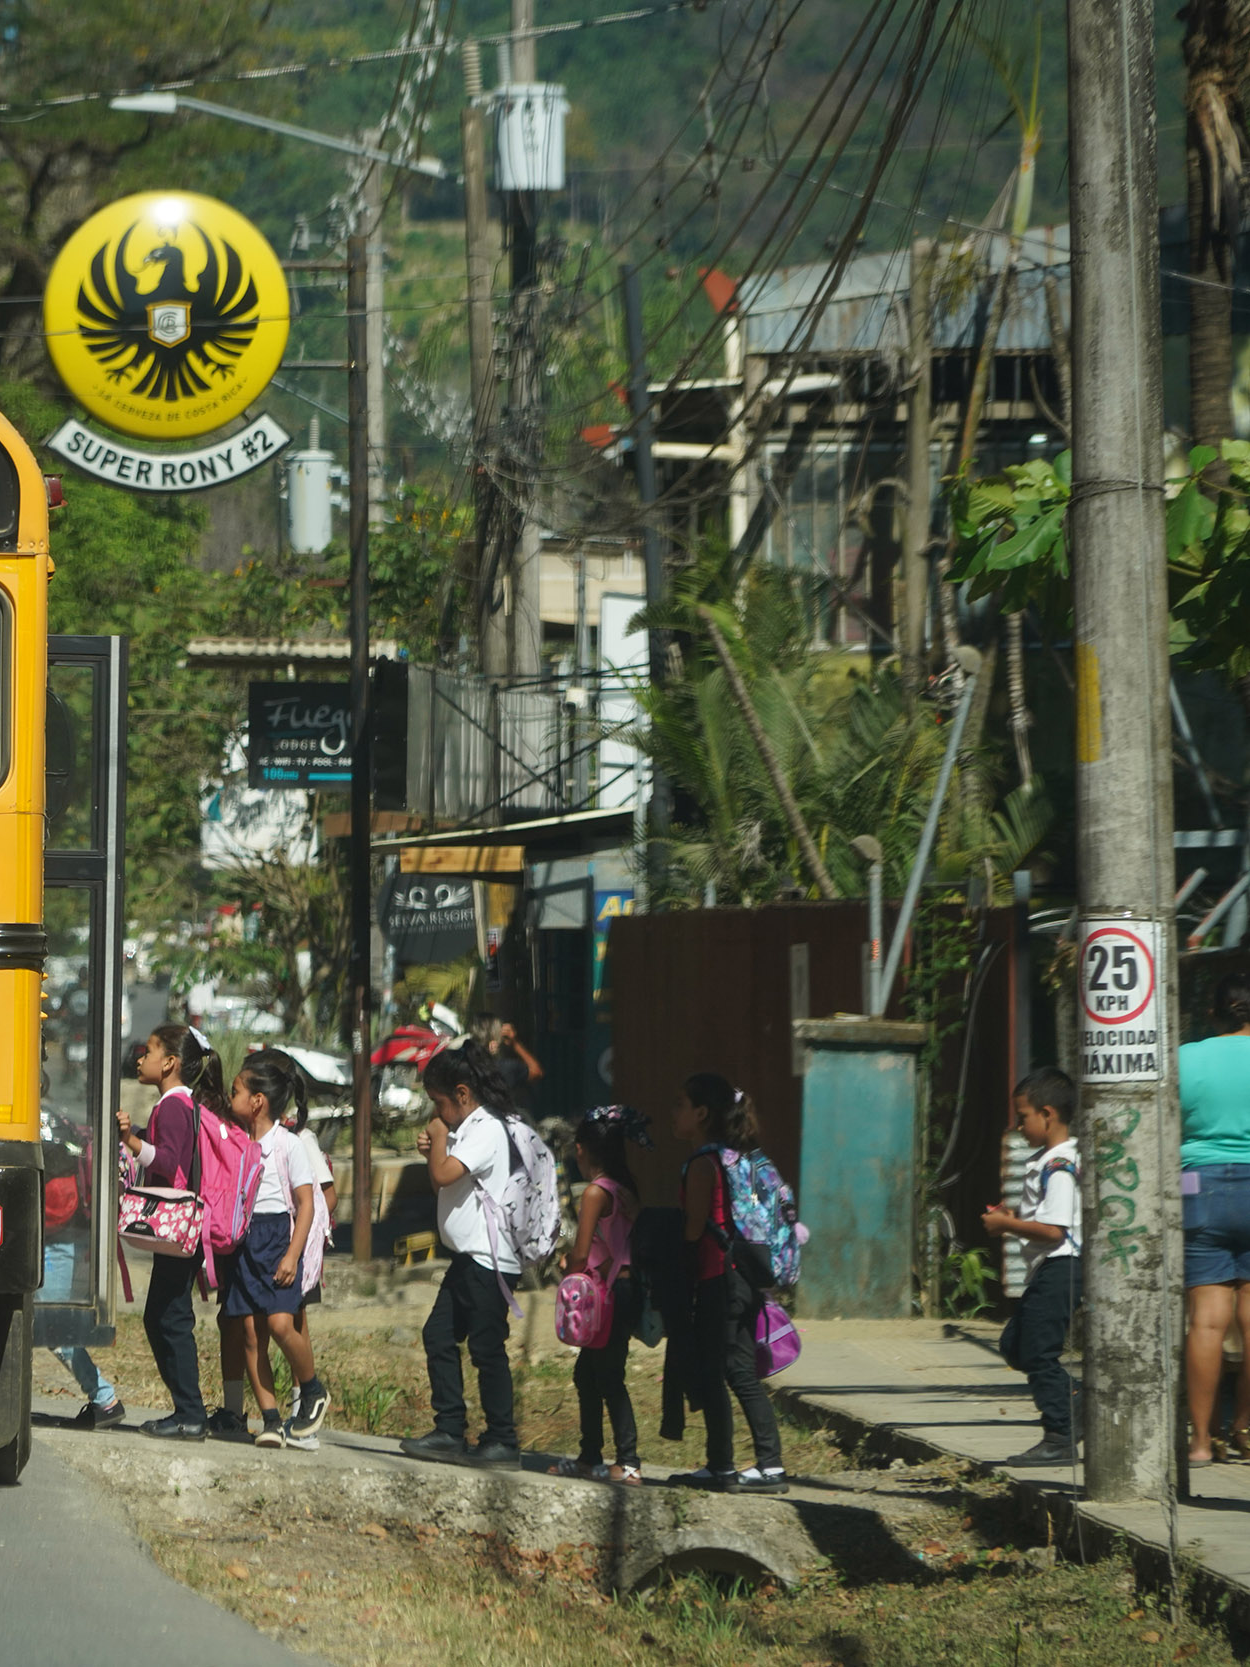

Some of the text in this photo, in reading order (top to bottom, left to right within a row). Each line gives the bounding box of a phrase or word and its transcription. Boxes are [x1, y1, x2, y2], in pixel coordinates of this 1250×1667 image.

[166, 413, 181, 422] DE
[185, 402, 219, 419] COSTA
[66, 430, 274, 487] SUPER RONY #2
[1088, 944, 1138, 991] 25
[1096, 995, 1129, 1012] KPH
[1080, 1029, 1157, 1047] ELOCIDAD
